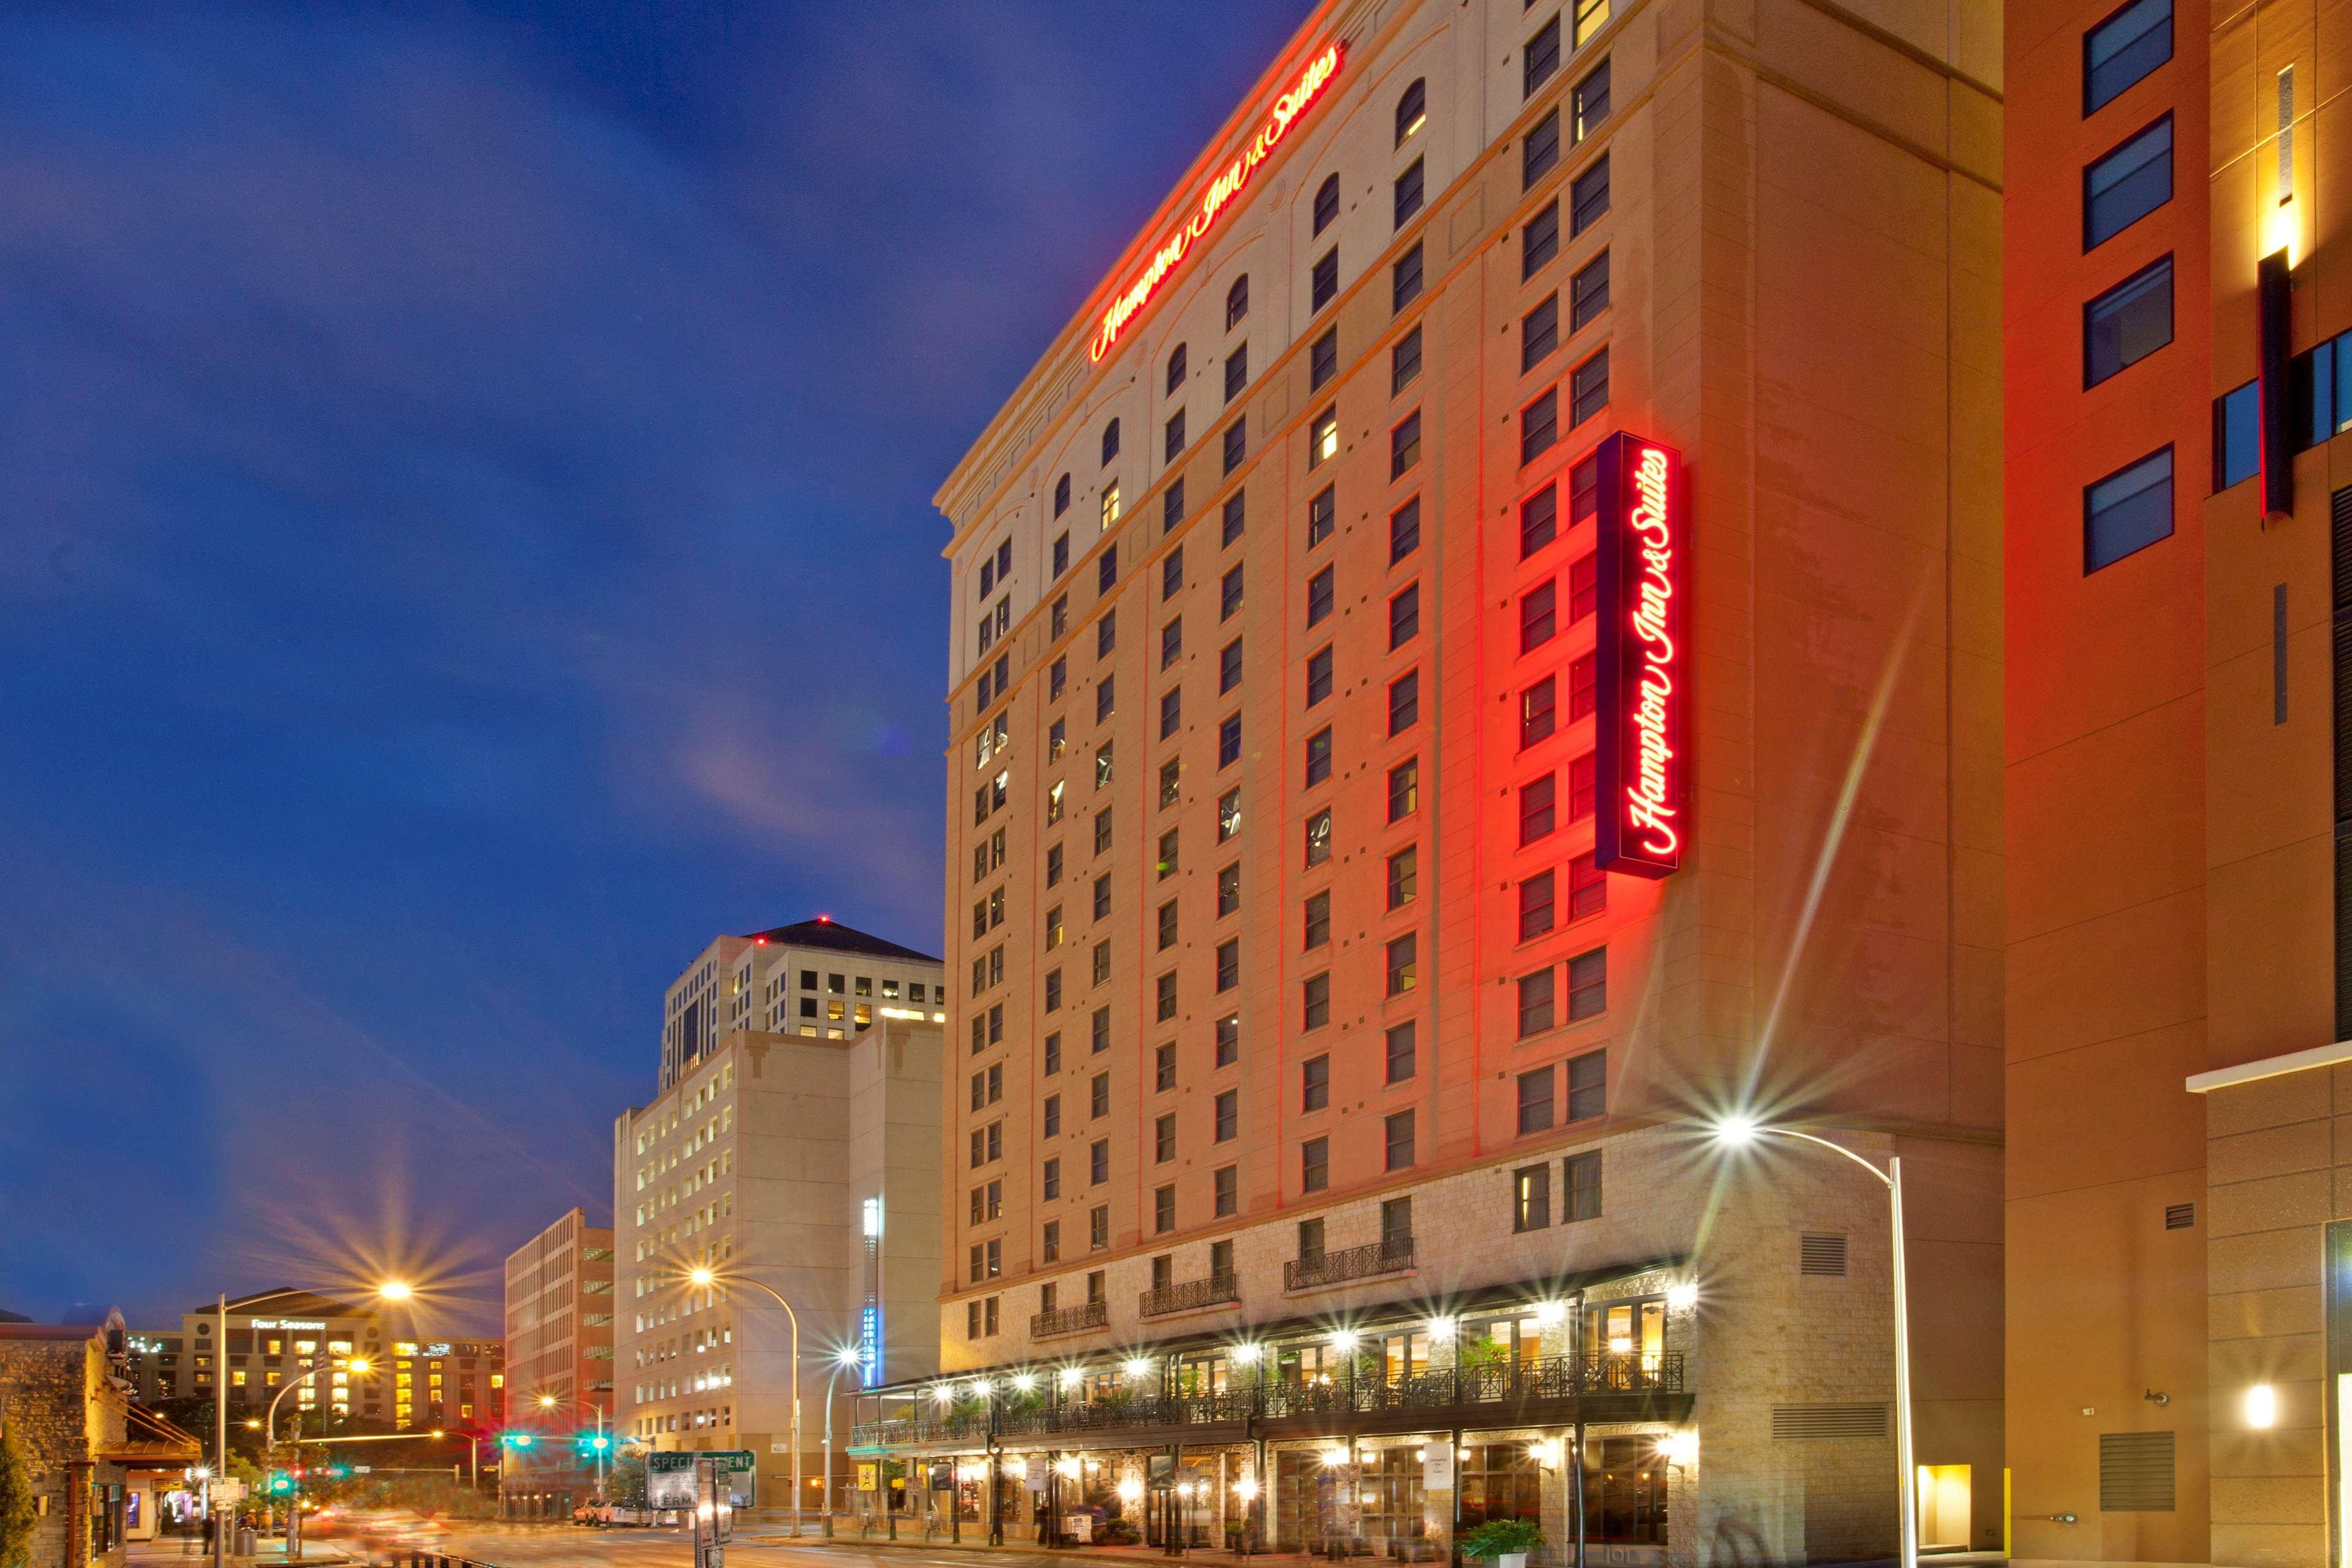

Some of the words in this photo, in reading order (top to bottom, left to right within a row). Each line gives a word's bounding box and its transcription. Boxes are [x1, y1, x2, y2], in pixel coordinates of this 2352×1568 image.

[1091, 225, 1191, 362] Hampton
[1192, 151, 1250, 238] Inn
[1250, 134, 1267, 166] &
[1265, 47, 1336, 146] Suites
[1631, 448, 1669, 549] Suites
[1642, 548, 1672, 572] &
[1632, 571, 1673, 664] Inn
[1627, 665, 1677, 854] Hampton
[251, 1319, 278, 1329] Four
[279, 1319, 326, 1330] Seasons
